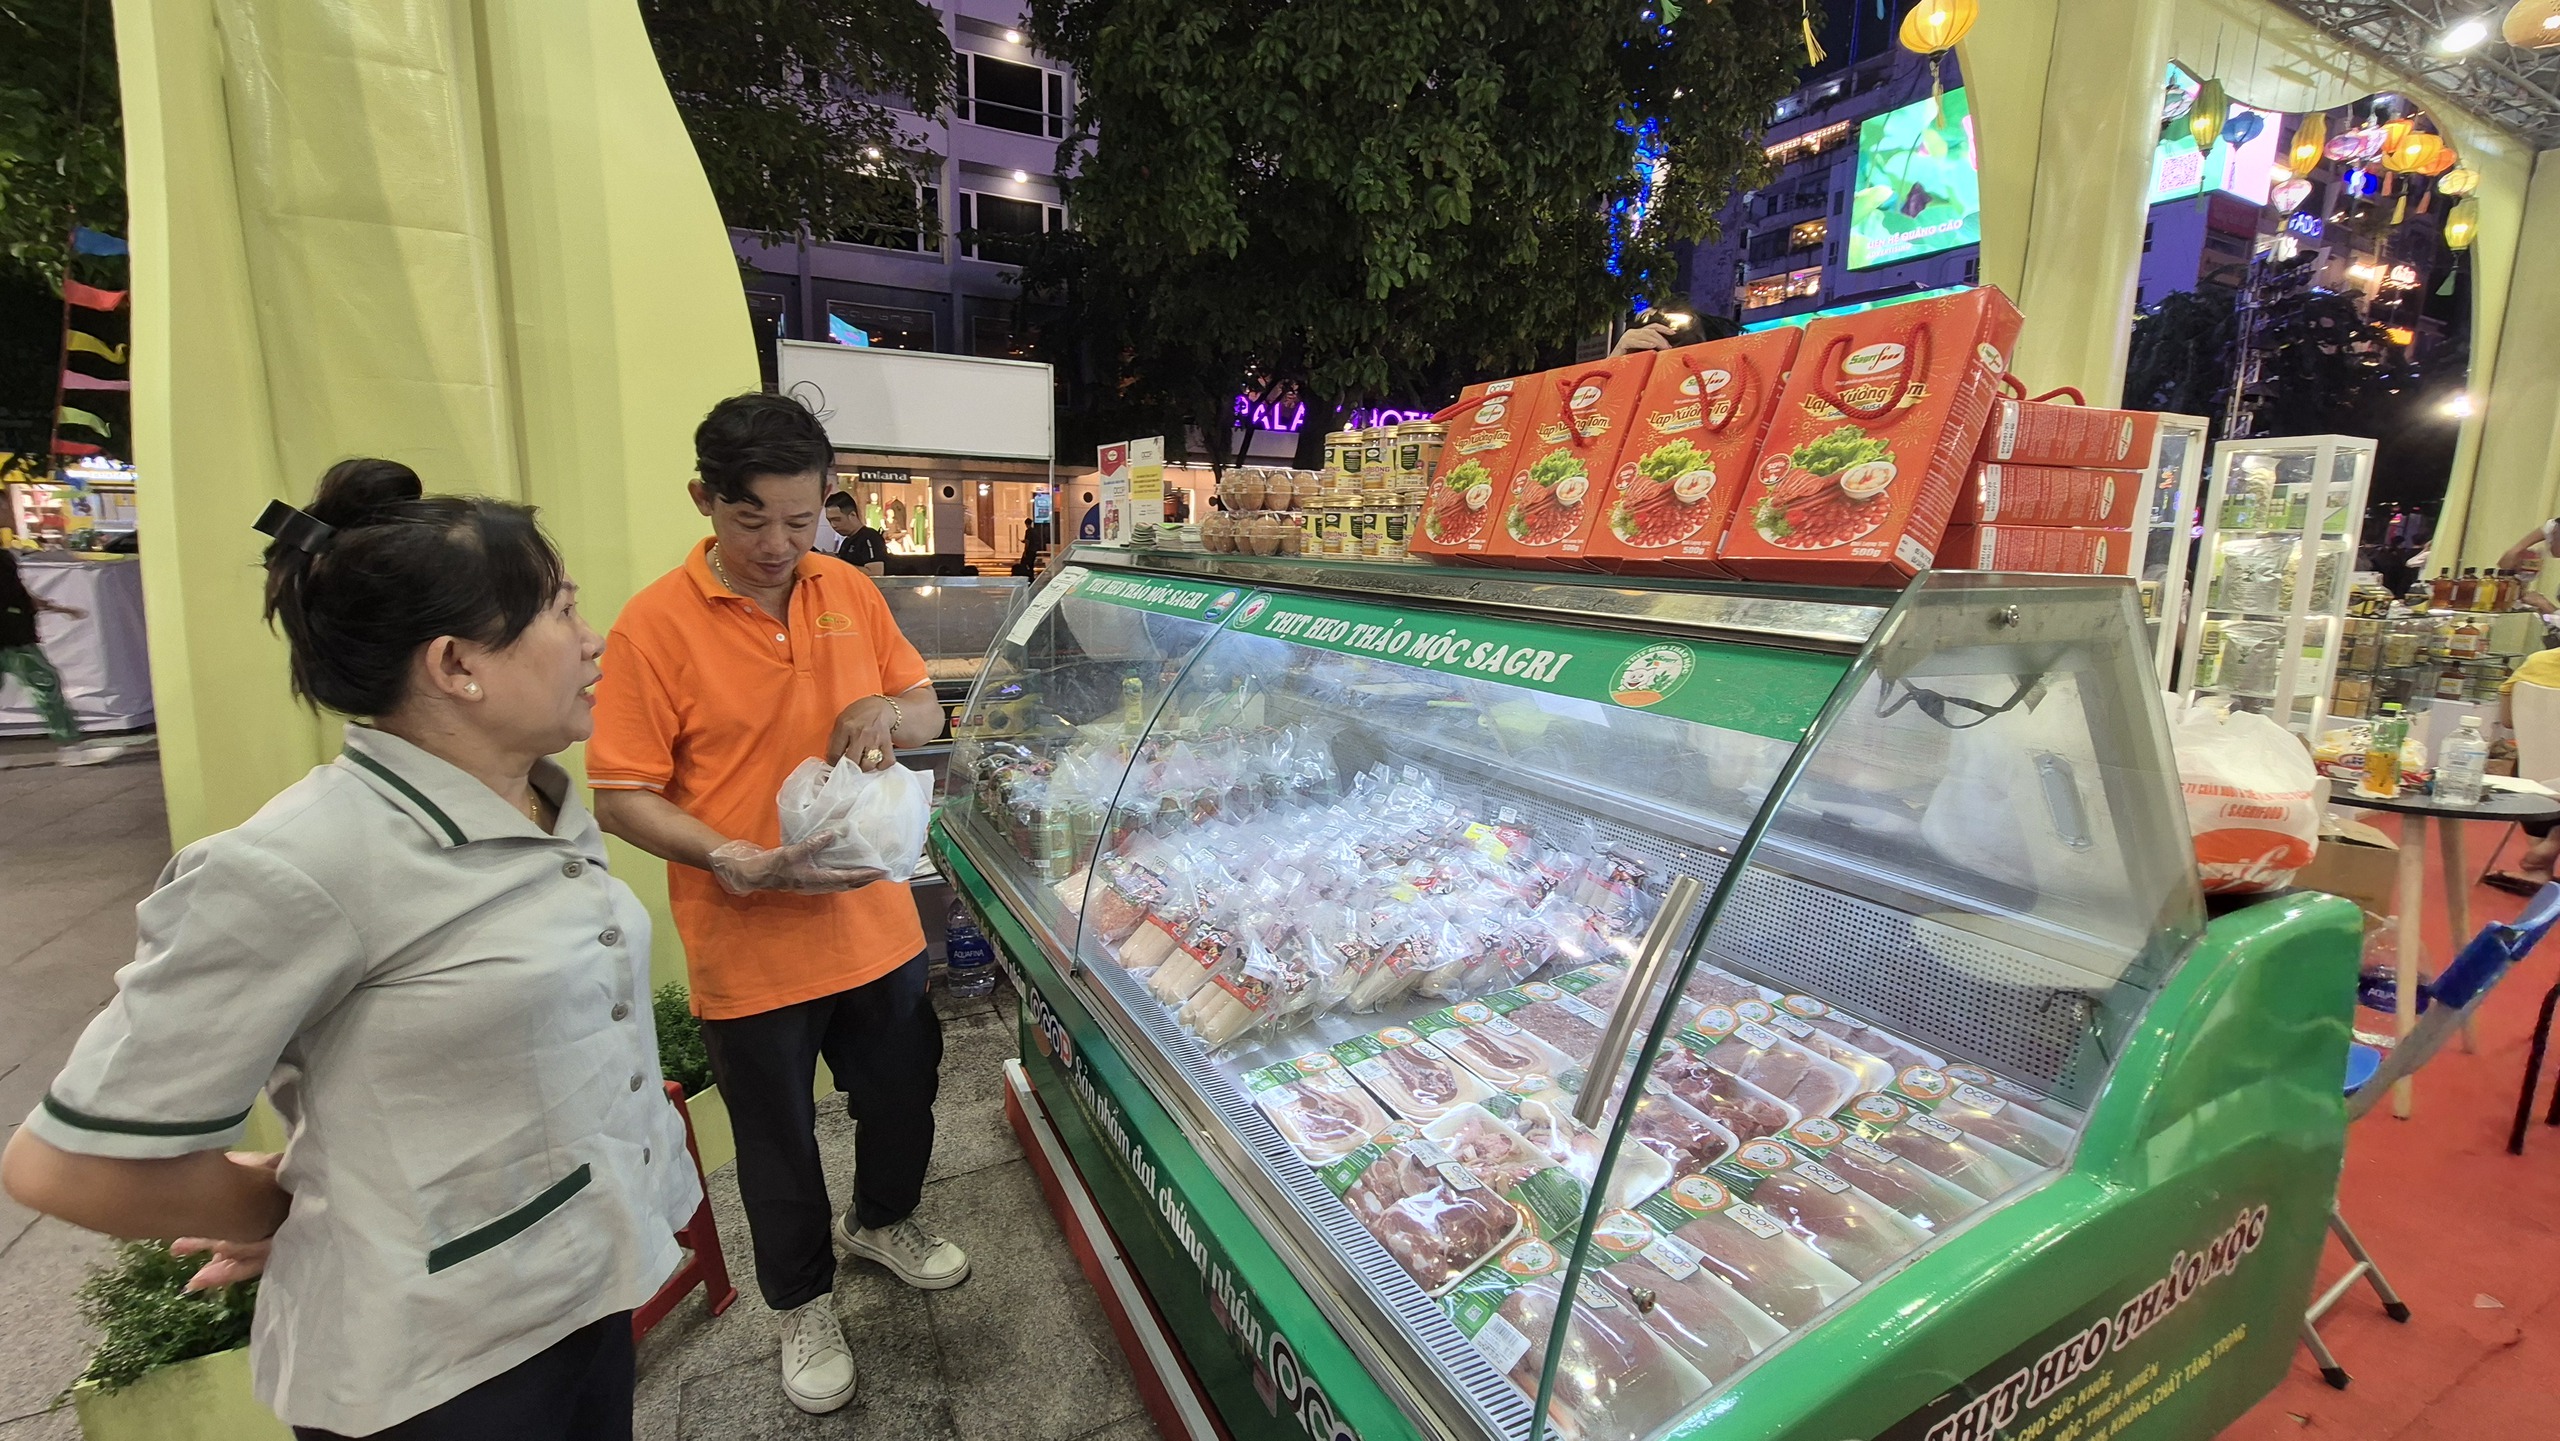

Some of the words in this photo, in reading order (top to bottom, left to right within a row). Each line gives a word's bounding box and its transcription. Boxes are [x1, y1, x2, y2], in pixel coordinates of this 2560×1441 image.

[861, 470, 908, 481] miana
[1682, 546, 1706, 556] 500g
[1851, 547, 1882, 558] 500g
[1085, 578, 1105, 596] THỊT
[1104, 582, 1126, 598] HEO
[1123, 579, 1152, 601] THẢO
[1146, 583, 1172, 606] MỘC
[1166, 589, 1209, 610] SAGRI
[1264, 611, 1314, 640] THỊT
[1303, 616, 1351, 643] HEO
[1344, 617, 1411, 654] THẢO
[1404, 628, 1472, 668] MỘC
[1464, 641, 1574, 683] SAGRI
[953, 949, 985, 959] AQUAFINA
[2367, 987, 2396, 1001] AQUA
[1495, 1018, 1518, 1031] OCOP
[1745, 1025, 1772, 1041] OCOP
[1964, 1087, 2001, 1105] OCOP
[1918, 1116, 1956, 1135] OCOP
[1855, 1137, 1893, 1156] OCOP
[1452, 1165, 1477, 1187] OCOP
[1807, 1164, 1844, 1187] OCOP
[1030, 987, 1074, 1068] OCOP
[1269, 1331, 1364, 1441] OC
[1739, 1207, 1776, 1231] OCOP
[1657, 1243, 1692, 1269] OCOP
[2026, 1318, 2111, 1408] HEO
[2112, 1250, 2203, 1351] THẢO
[2200, 1204, 2268, 1285] MỘC
